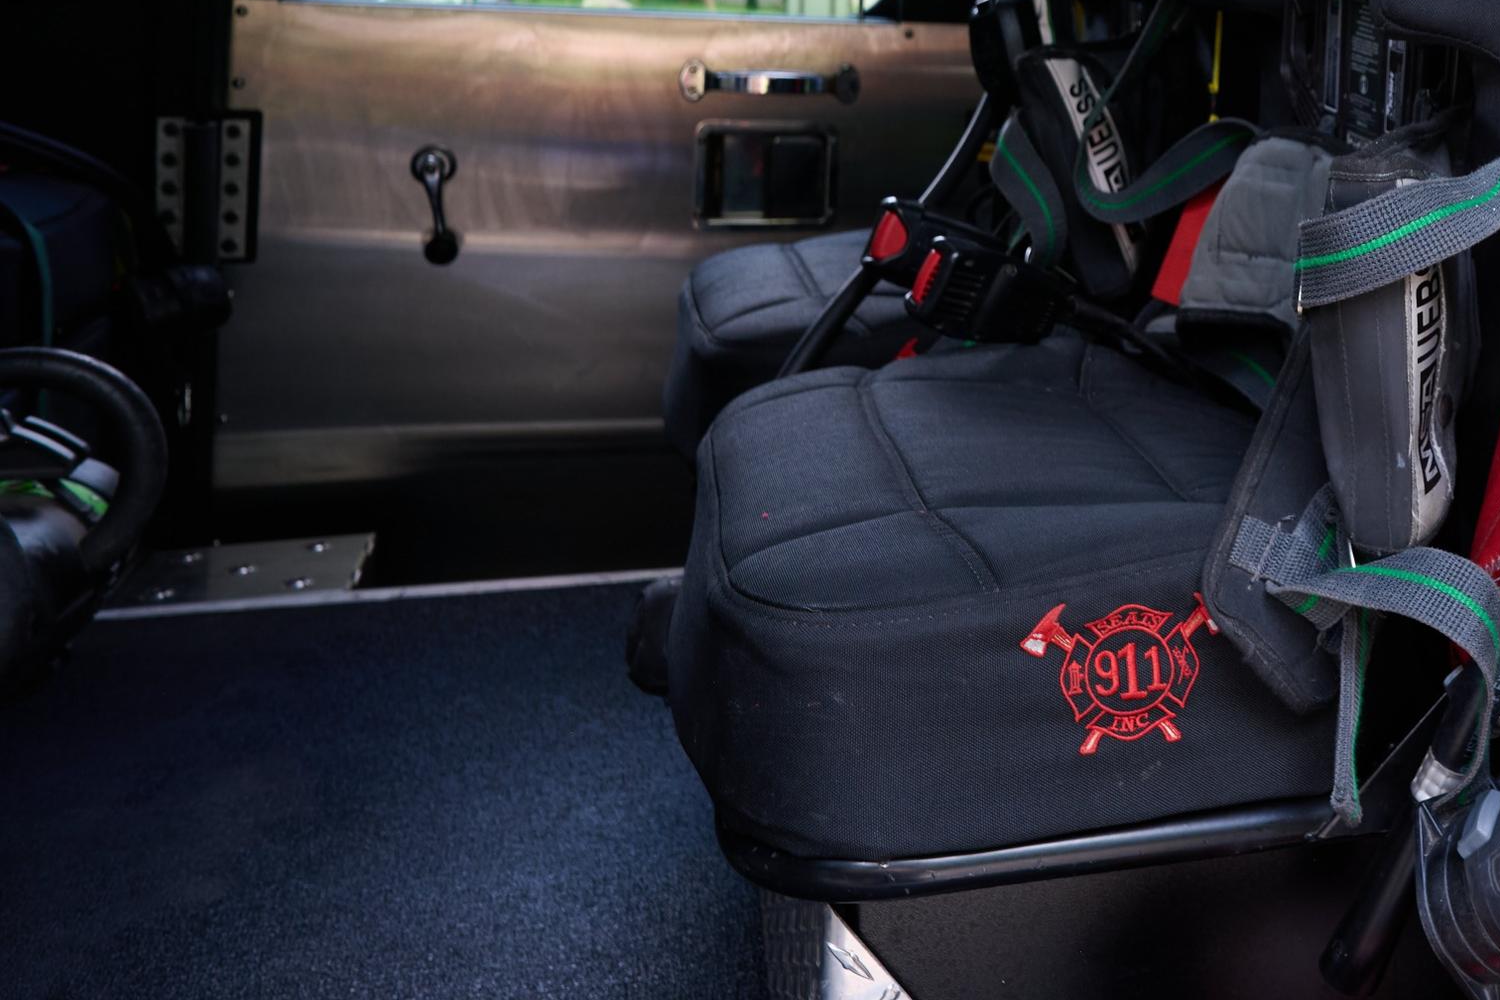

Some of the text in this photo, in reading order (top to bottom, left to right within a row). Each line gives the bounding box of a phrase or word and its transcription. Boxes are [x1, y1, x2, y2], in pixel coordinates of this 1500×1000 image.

[1416, 262, 1441, 364] UEB
[1097, 610, 1163, 634] SEATS
[1093, 641, 1168, 700] 911
[1111, 712, 1151, 733] INC
